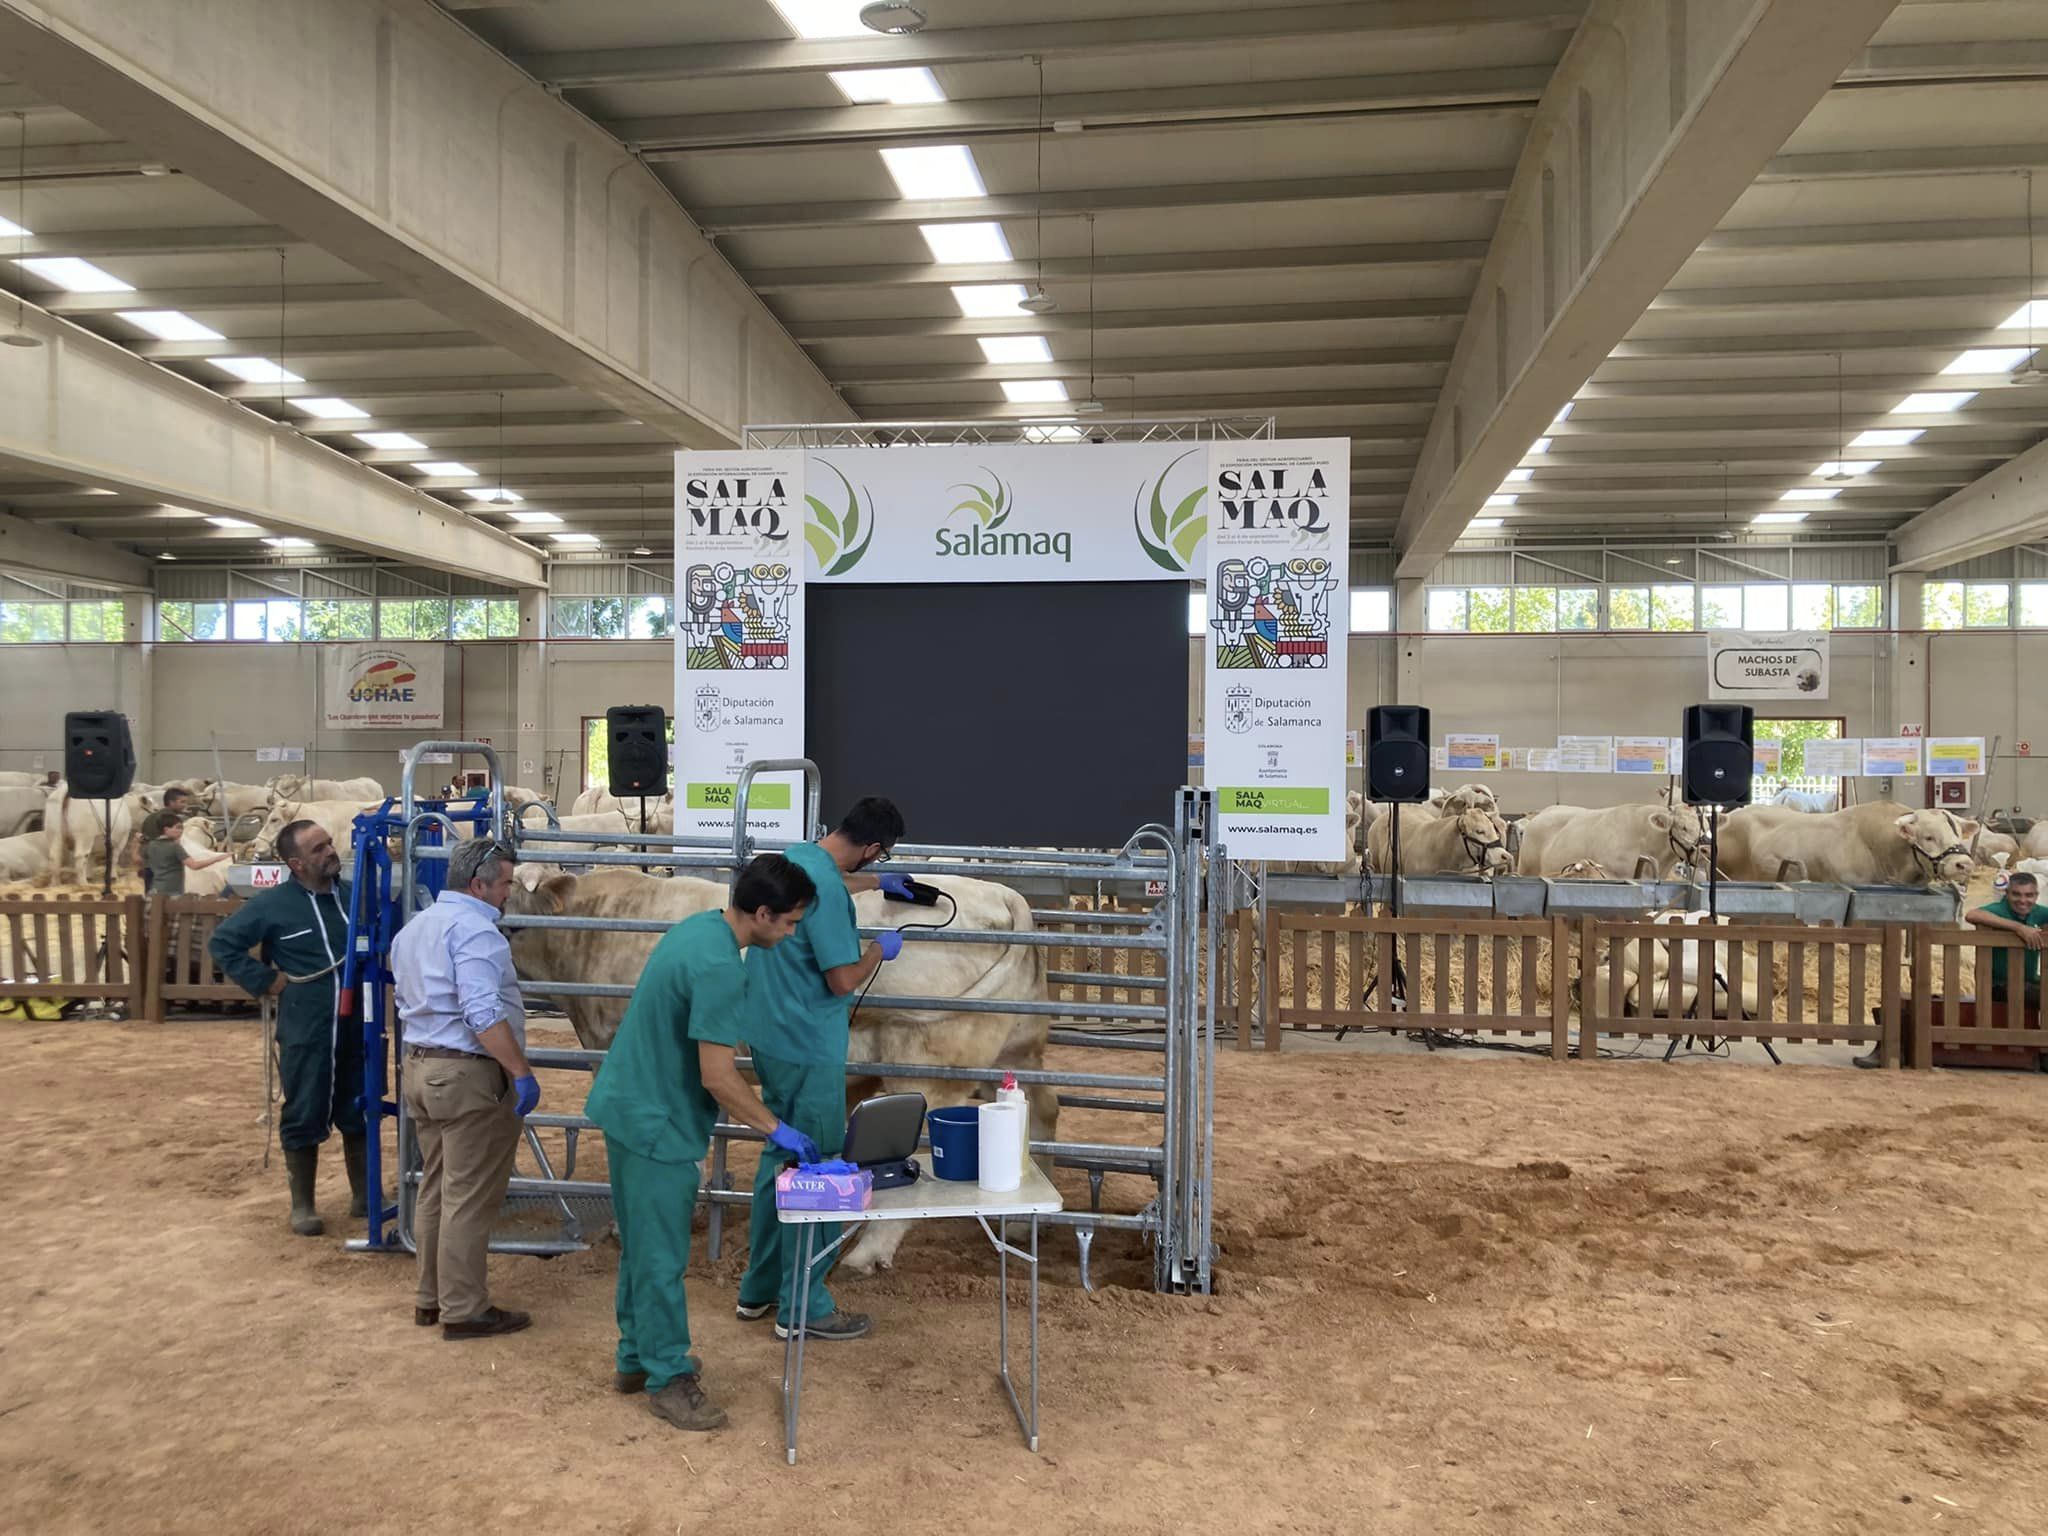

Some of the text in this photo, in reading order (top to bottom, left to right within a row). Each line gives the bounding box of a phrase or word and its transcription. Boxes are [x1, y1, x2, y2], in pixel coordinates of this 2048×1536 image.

[1218, 469, 1329, 499] SALA
[686, 479, 788, 507] SALA
[1218, 499, 1330, 534] MAQ
[686, 507, 789, 540] MAQ
[936, 524, 1071, 562] Salamaq
[1738, 656, 1798, 664] MACHOS DE
[1745, 668, 1790, 676] SUBASTA
[722, 698, 774, 708] Diputación
[1255, 698, 1311, 709] Diputación
[722, 716, 784, 726] de Salamanca
[1268, 716, 1322, 727] Salamanca
[705, 795, 729, 804] MAQ
[1236, 800, 1263, 809] MAQ
[1228, 825, 1318, 835] www.salamaq.es
